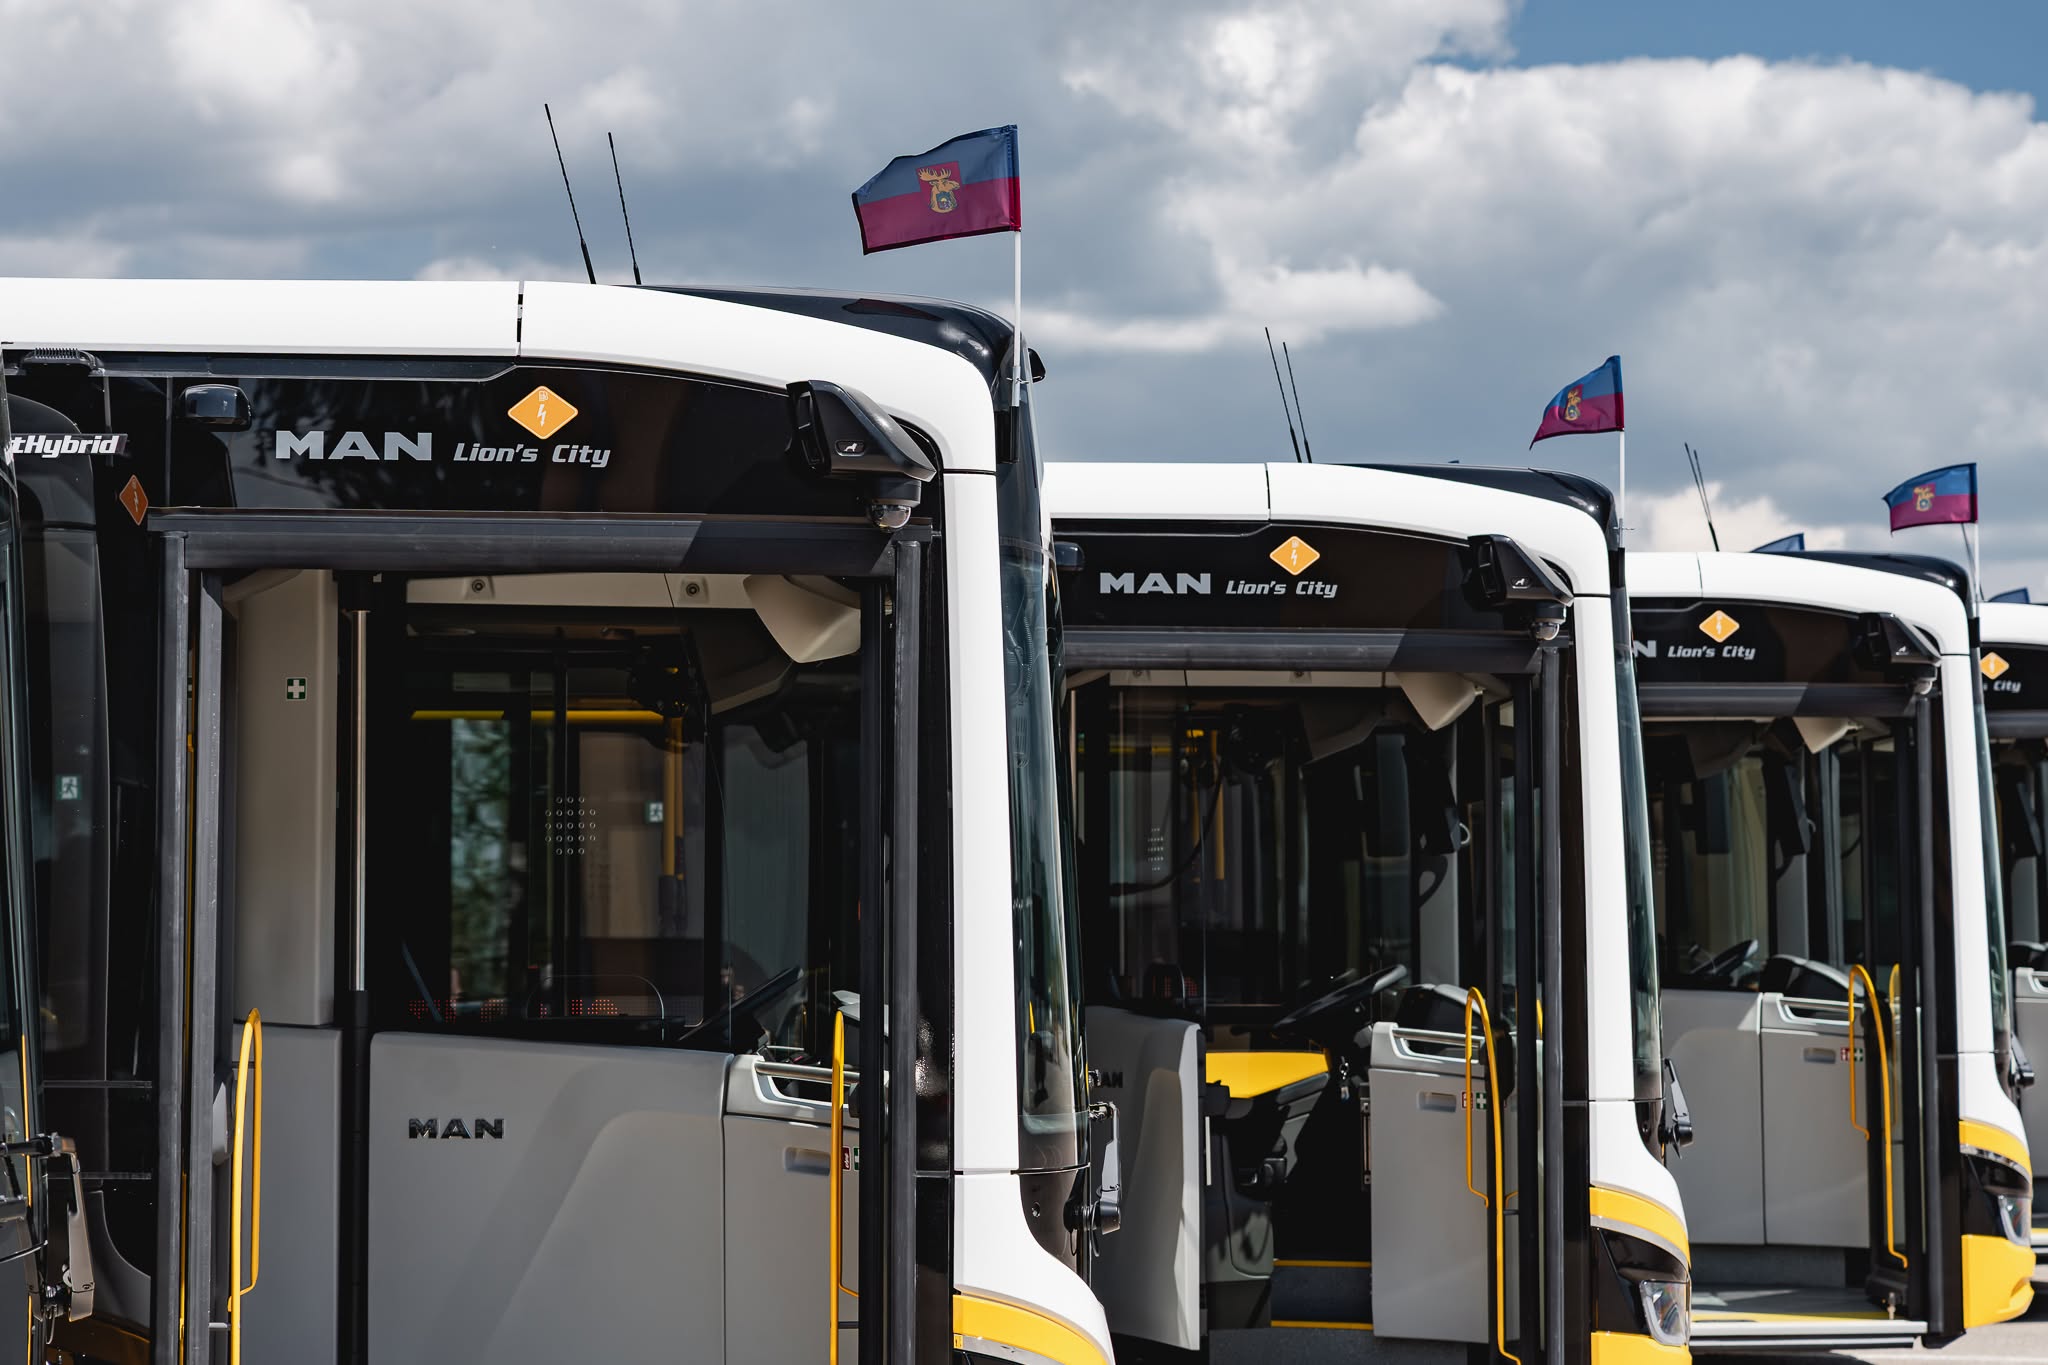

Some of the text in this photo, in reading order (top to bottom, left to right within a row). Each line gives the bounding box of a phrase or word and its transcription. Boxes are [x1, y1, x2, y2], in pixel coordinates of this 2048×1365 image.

[275, 430, 611, 468] MAN Lion's City
[1100, 572, 1338, 598] MAN Lion's City
[1667, 645, 1716, 658] Lion's
[1722, 645, 1756, 660] City
[1993, 680, 2022, 694] City
[1099, 1071, 1124, 1089] AN
[408, 1118, 505, 1139] MAN
